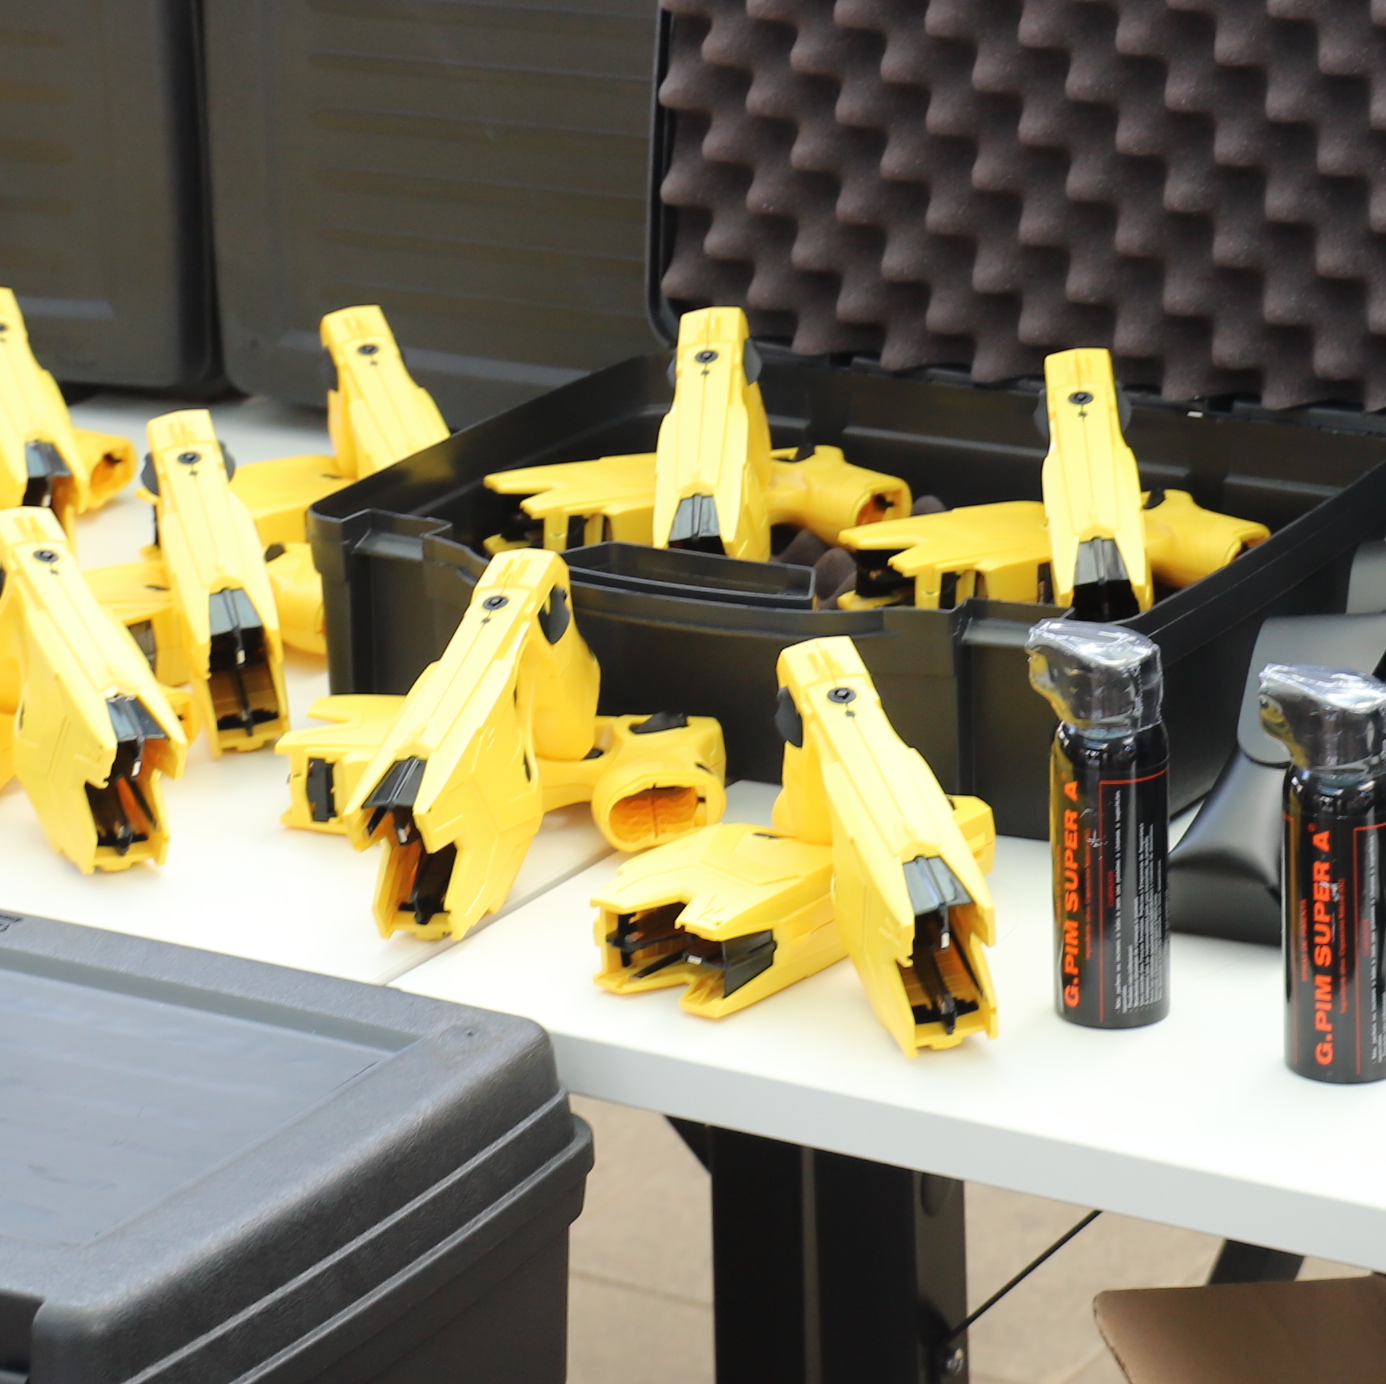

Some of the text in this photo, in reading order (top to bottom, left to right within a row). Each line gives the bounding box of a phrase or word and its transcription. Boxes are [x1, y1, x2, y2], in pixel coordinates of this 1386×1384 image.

[1063, 809, 1080, 912] SUPER
[1313, 860, 1333, 967] SUPER
[1064, 920, 1081, 1007] G.PIM
[1314, 974, 1334, 1065] G.PIM
